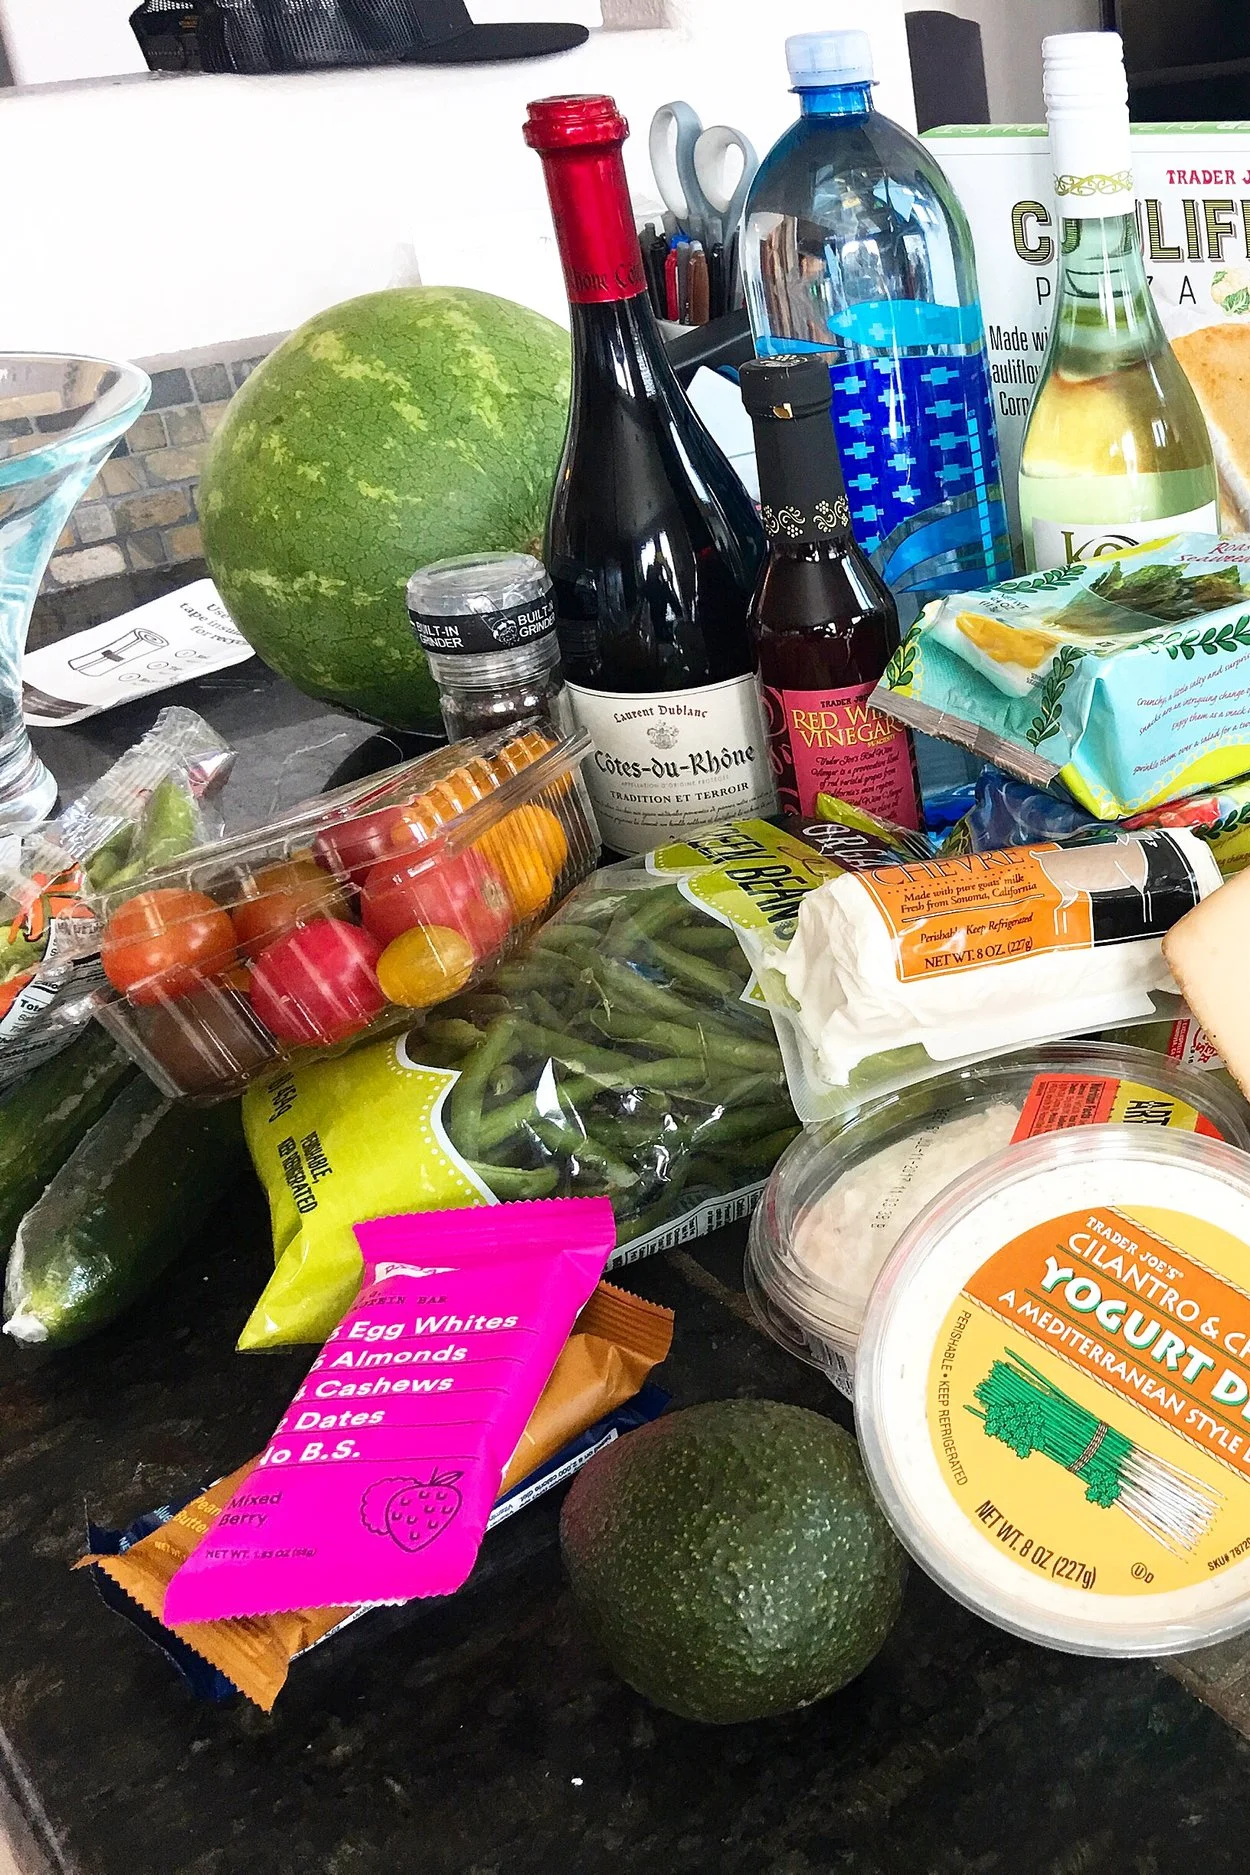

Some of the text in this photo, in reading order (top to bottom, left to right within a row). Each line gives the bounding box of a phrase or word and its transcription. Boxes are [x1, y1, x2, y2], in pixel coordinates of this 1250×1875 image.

[1166, 169, 1236, 185] TRADER
[989, 325, 1028, 351] Made
[180, 602, 209, 622] tape
[190, 625, 211, 638] for
[419, 633, 464, 648] GRINDER
[614, 705, 708, 723] Laurent Dublanc
[791, 709, 839, 731] RED
[800, 715, 904, 748] VINEGAR
[610, 782, 750, 804] TRADITION ET TERROIR
[900, 881, 1038, 914] Fresh from Sonoma, California
[903, 872, 1025, 903] Made with pure milk
[987, 912, 1035, 934] Refrigerated
[924, 936, 1035, 969] NET (227g)
[1085, 1216, 1180, 1281] TRADER JOE'S
[1067, 1232, 1201, 1322] CILANTRO
[1200, 1316, 1221, 1340] &
[347, 1314, 519, 1343] Egg Whites
[1039, 1255, 1217, 1385] YOGURT
[331, 1344, 469, 1369] Almonds
[997, 1288, 1017, 1309] A
[1017, 1300, 1187, 1417] MEDITERRANEAN
[1184, 1407, 1243, 1456] STYLE
[315, 1376, 454, 1399] Cashews
[937, 1310, 972, 1487] PERISHABLE REFRIGERATED
[294, 1408, 386, 1432] Dates
[299, 1440, 361, 1463] B.S.
[229, 1491, 282, 1510] Mixed
[218, 1512, 268, 1528] Berry
[975, 1499, 1099, 1591] NET OZ (227g)
